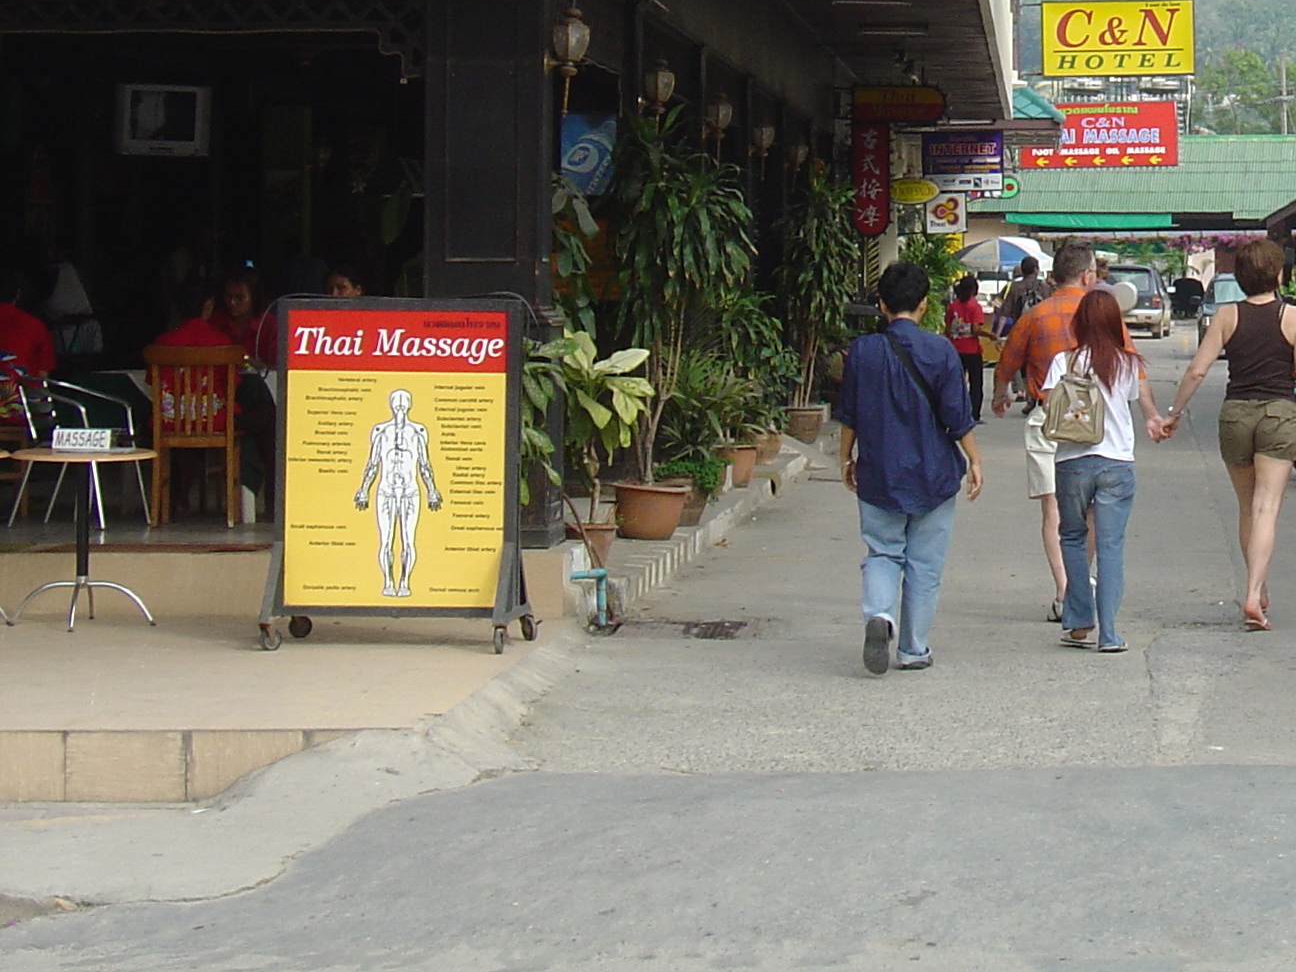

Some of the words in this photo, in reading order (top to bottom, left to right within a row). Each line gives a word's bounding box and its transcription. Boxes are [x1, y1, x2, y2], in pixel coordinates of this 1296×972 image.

[1056, 53, 1182, 70] HOTEL
[1080, 116, 1125, 129] C&N
[1083, 128, 1160, 144] MASSAGE
[929, 142, 998, 156] INTERNET
[294, 327, 363, 356] Thai
[372, 329, 504, 365] Massage
[55, 430, 106, 448] MASSAGE
